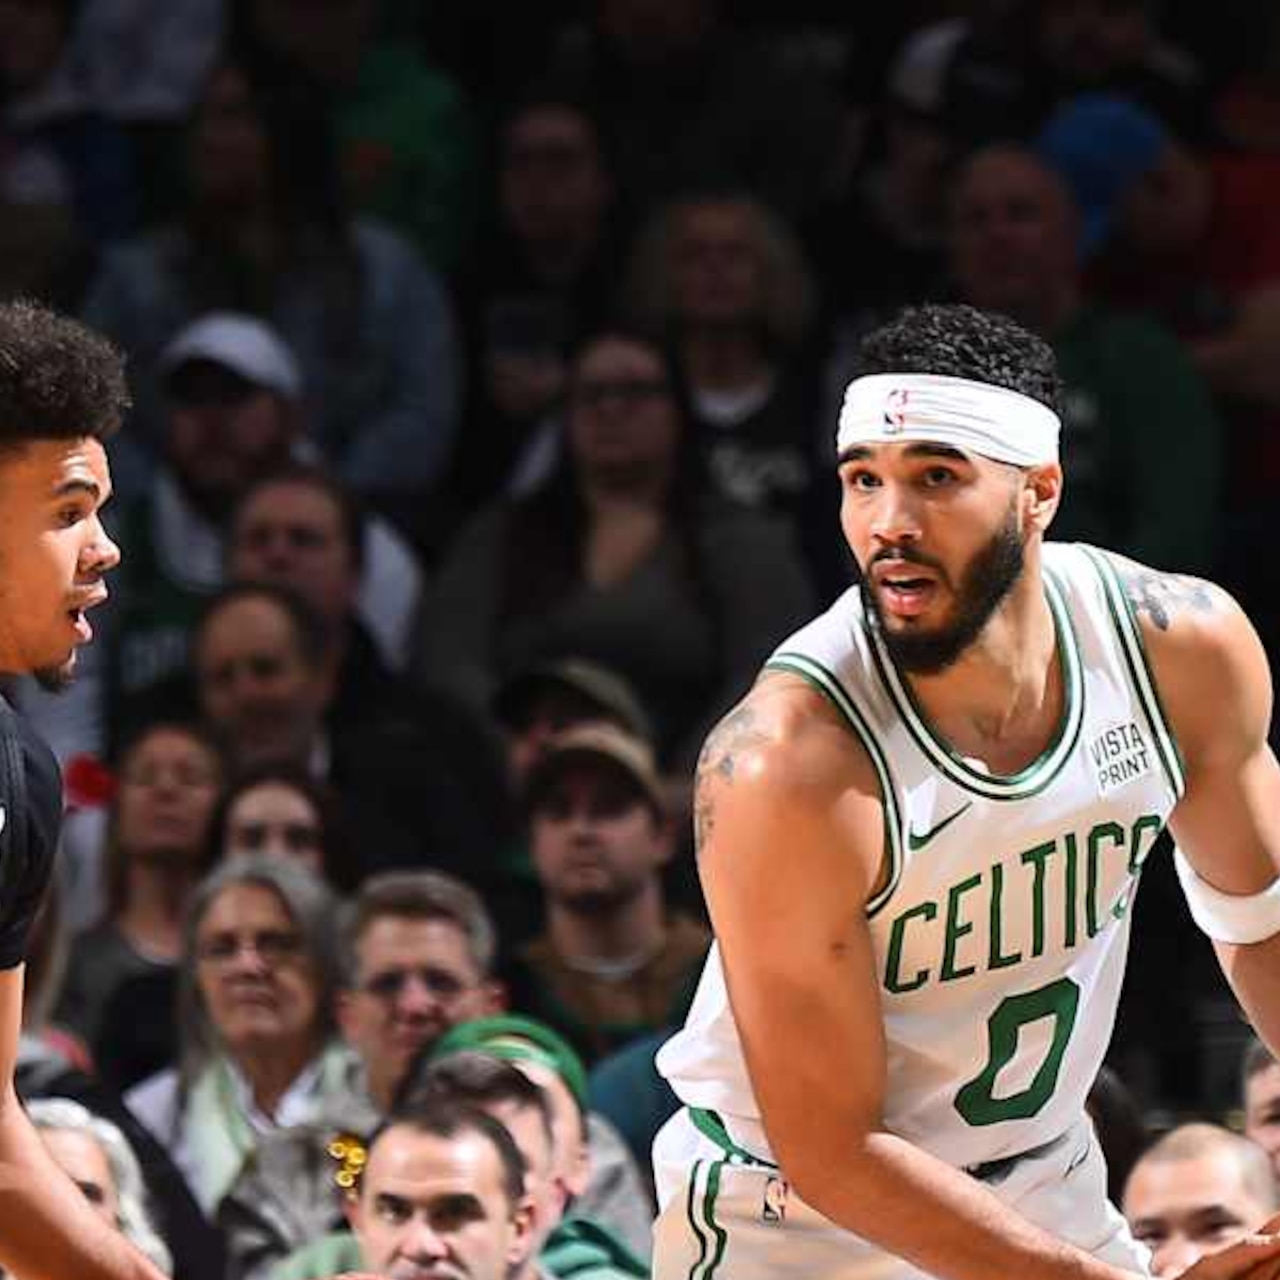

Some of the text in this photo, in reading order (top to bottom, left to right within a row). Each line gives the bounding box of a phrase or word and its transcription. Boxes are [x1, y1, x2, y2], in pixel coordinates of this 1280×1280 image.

[1090, 723, 1145, 766] VISTA
[1098, 749, 1149, 790] PRINT
[954, 977, 1081, 1126] 0
